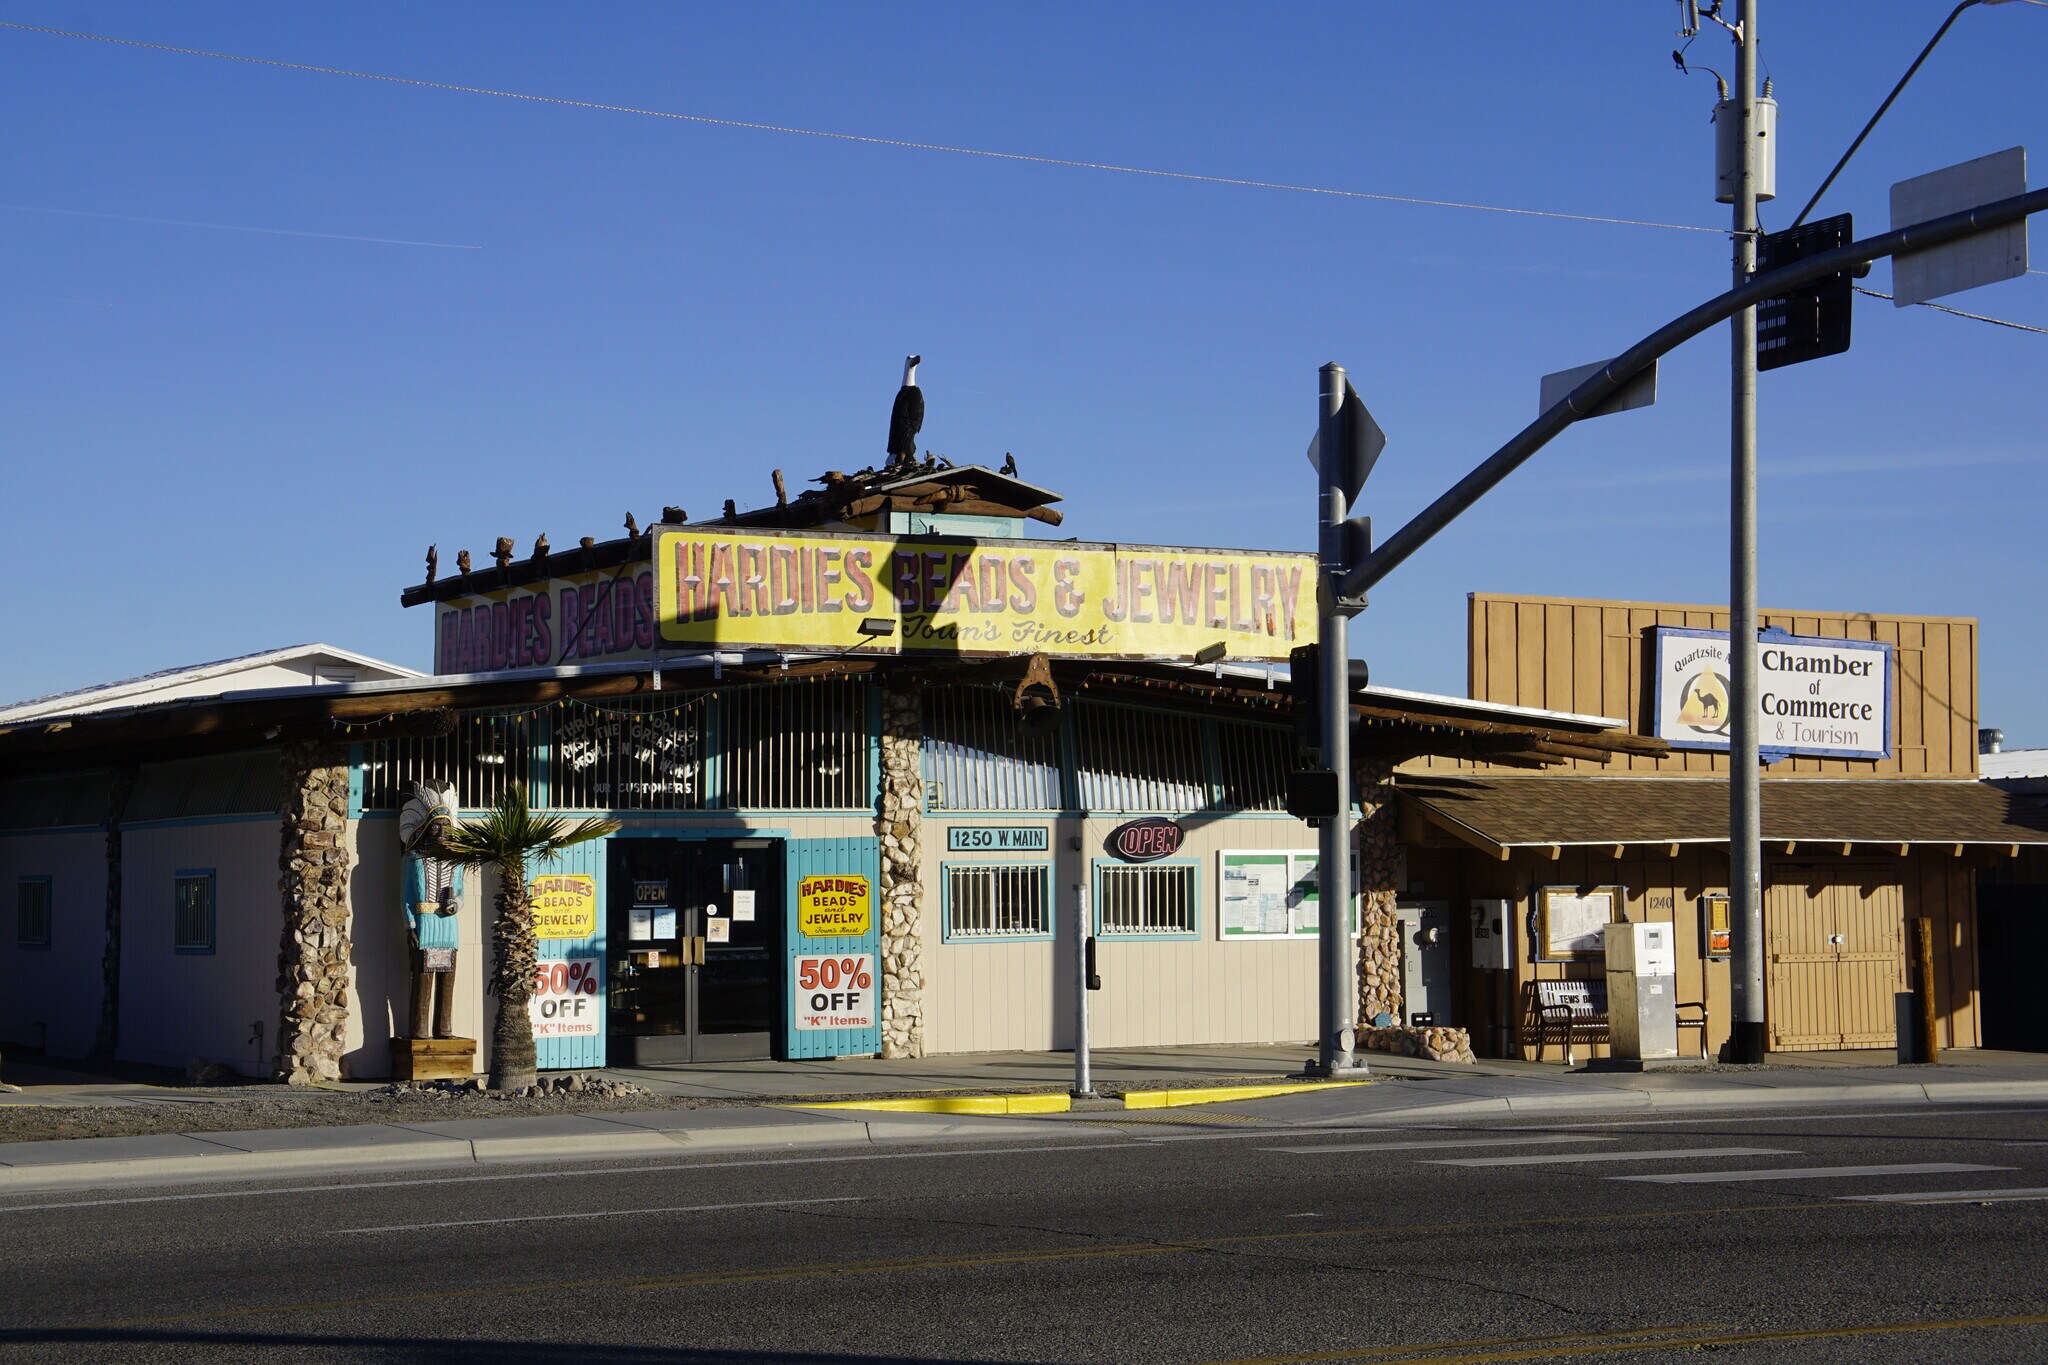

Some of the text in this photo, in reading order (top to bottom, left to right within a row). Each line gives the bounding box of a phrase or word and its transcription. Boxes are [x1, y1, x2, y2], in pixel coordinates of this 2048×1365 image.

[675, 540, 1303, 642] HARDIES BEADS & JEWELRY
[441, 571, 653, 675] HARDIES BEADS
[901, 616, 1113, 646] Town's Finest
[1674, 645, 1722, 672] Quartzsite
[1761, 650, 1873, 677] Chamber
[1809, 679, 1821, 695] of
[1761, 692, 1872, 721] Commerce
[1775, 721, 1859, 745] & Tourism
[954, 830, 992, 847] 1250
[1013, 830, 1043, 846] MAIN
[1124, 826, 1178, 854] OPEN
[533, 879, 592, 897] HARDIES
[636, 885, 666, 901] OPEN
[801, 879, 867, 898] HARDIES
[544, 896, 583, 908] BEADS
[813, 896, 857, 907] BEADS
[1649, 896, 1672, 910] 1240
[538, 914, 589, 926] JEWELRY
[806, 913, 864, 925] JEWELRY
[533, 962, 597, 996] 50%
[799, 957, 871, 990] 50%
[540, 999, 587, 1019] OFF
[810, 992, 860, 1012] OFF
[534, 1023, 593, 1034] "K" Items
[804, 1015, 868, 1026] "K" Items
